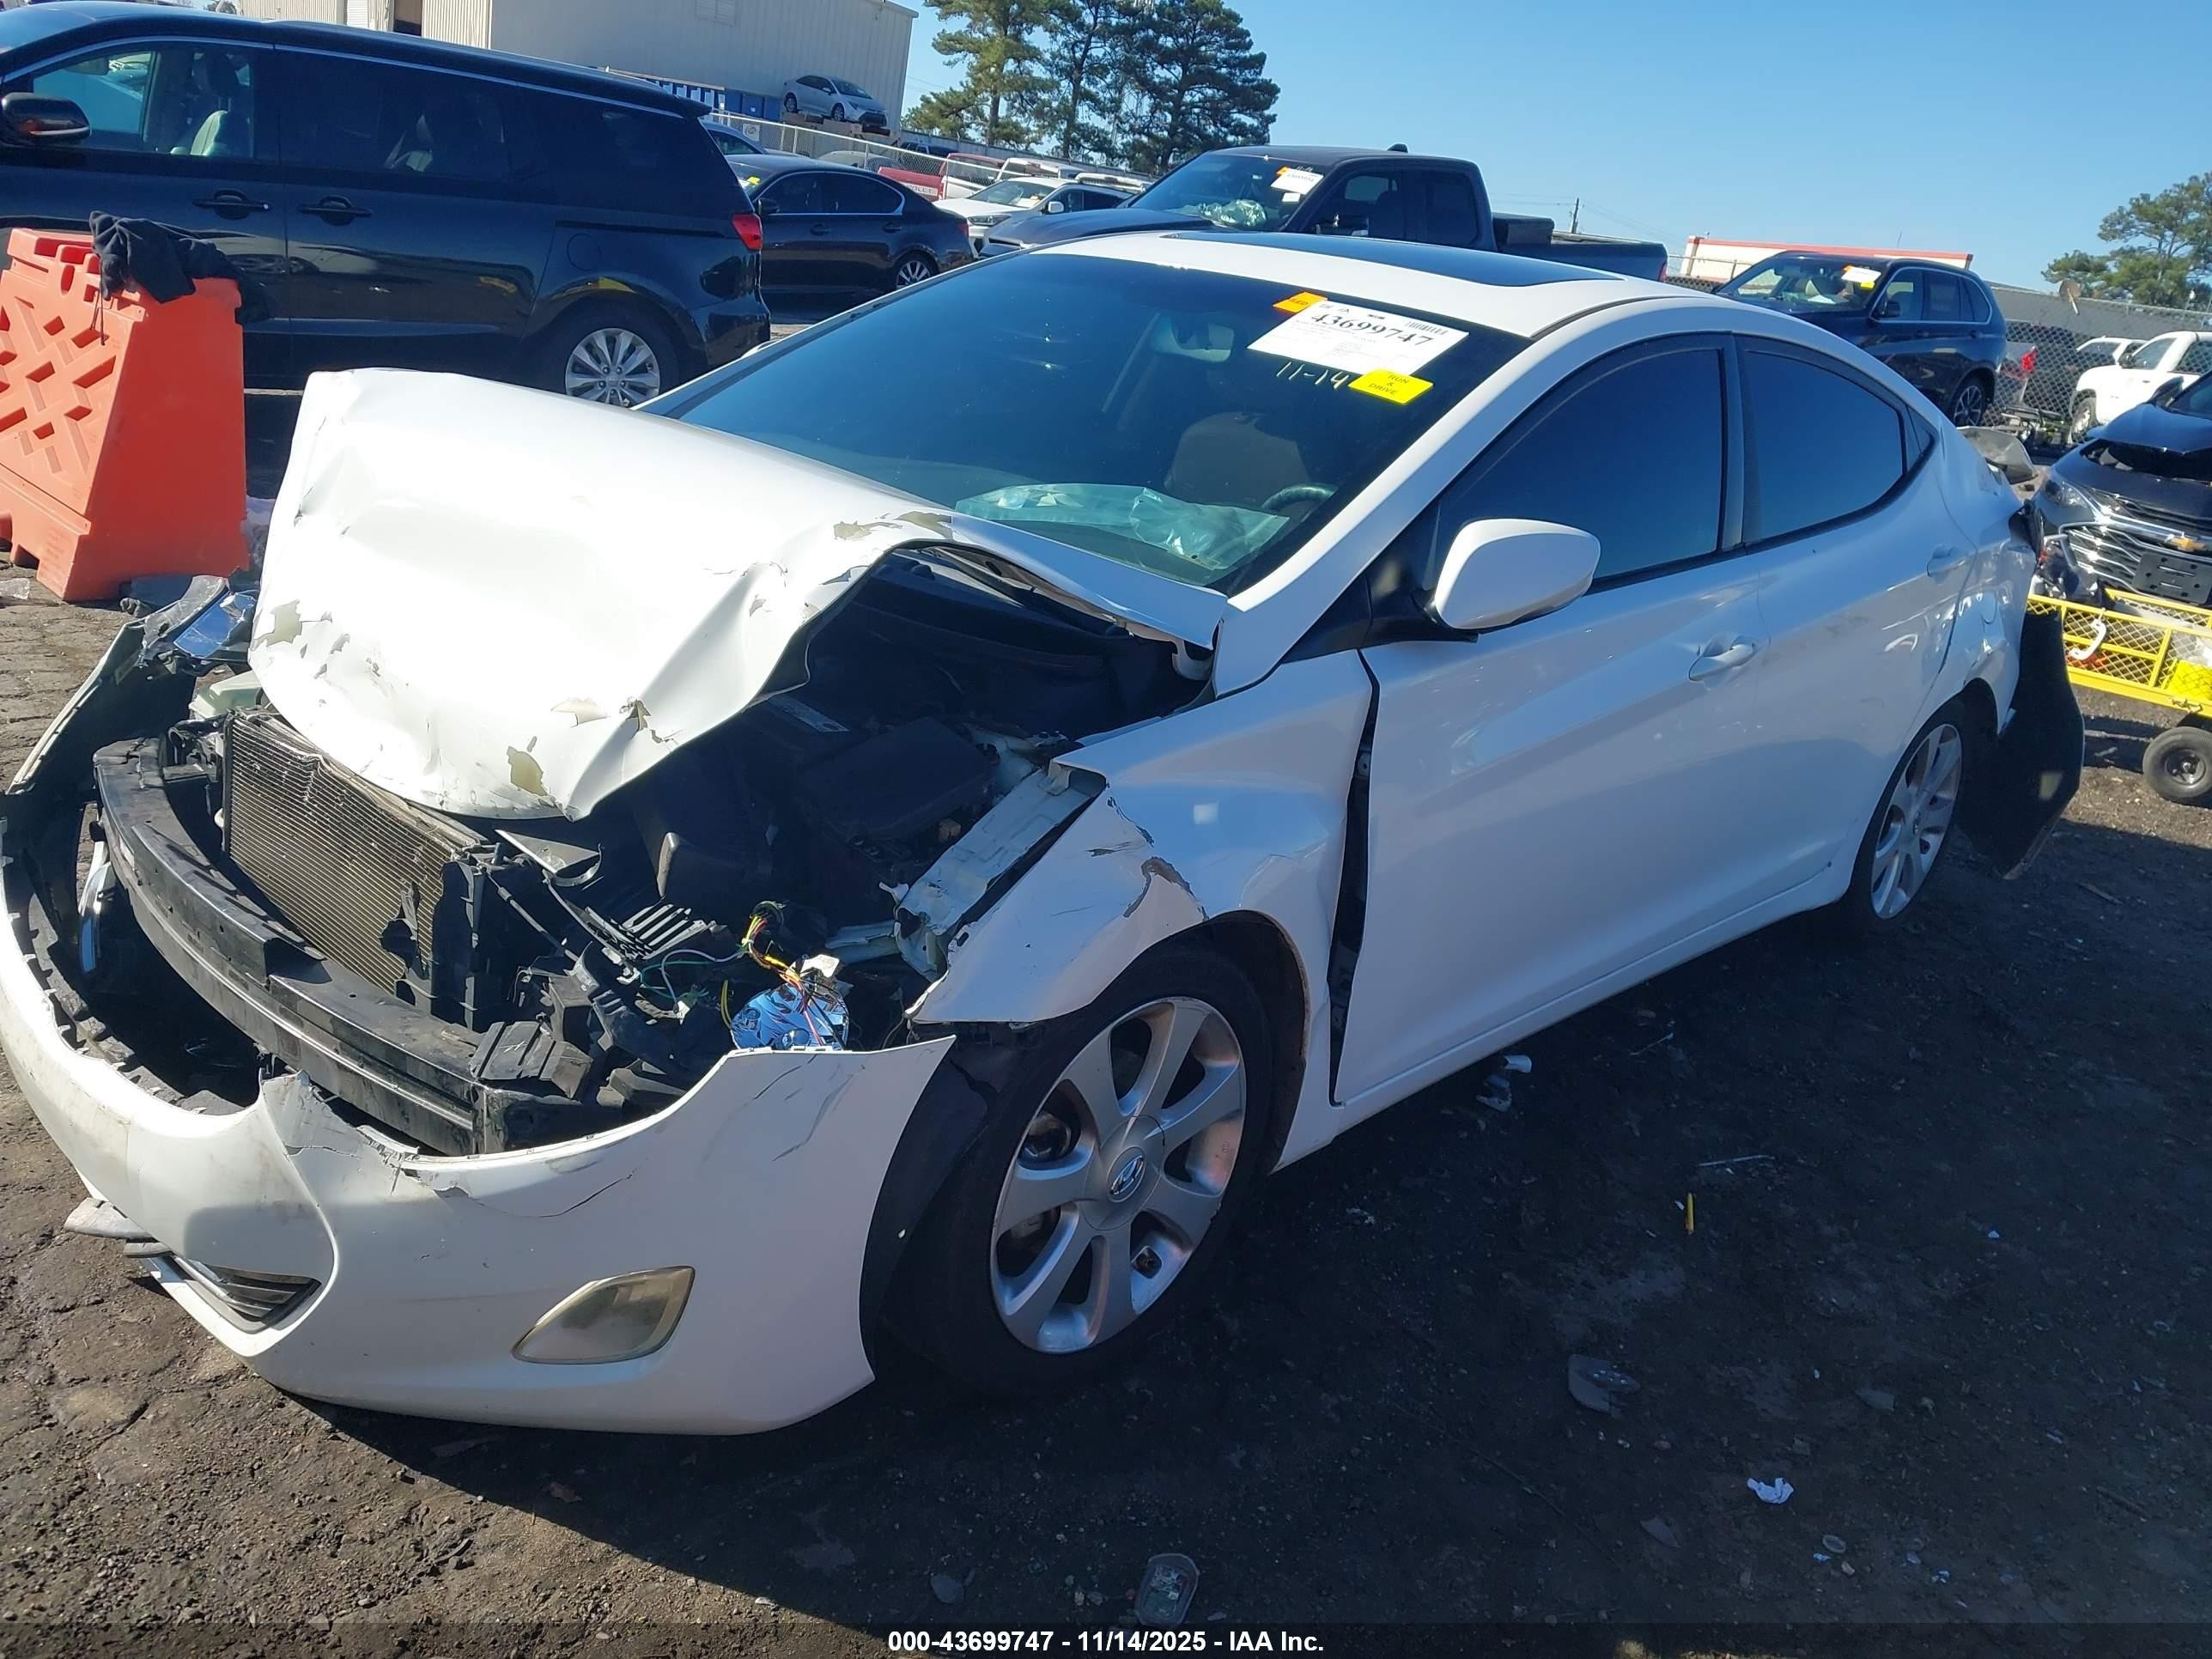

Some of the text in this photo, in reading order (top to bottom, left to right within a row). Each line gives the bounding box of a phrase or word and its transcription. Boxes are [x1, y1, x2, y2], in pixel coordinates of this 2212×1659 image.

[1310, 313, 1434, 346] 43699747
[1275, 361, 1351, 389] 11-14
[1387, 374, 1410, 384] RUN
[1368, 382, 1399, 395] DRIVE
